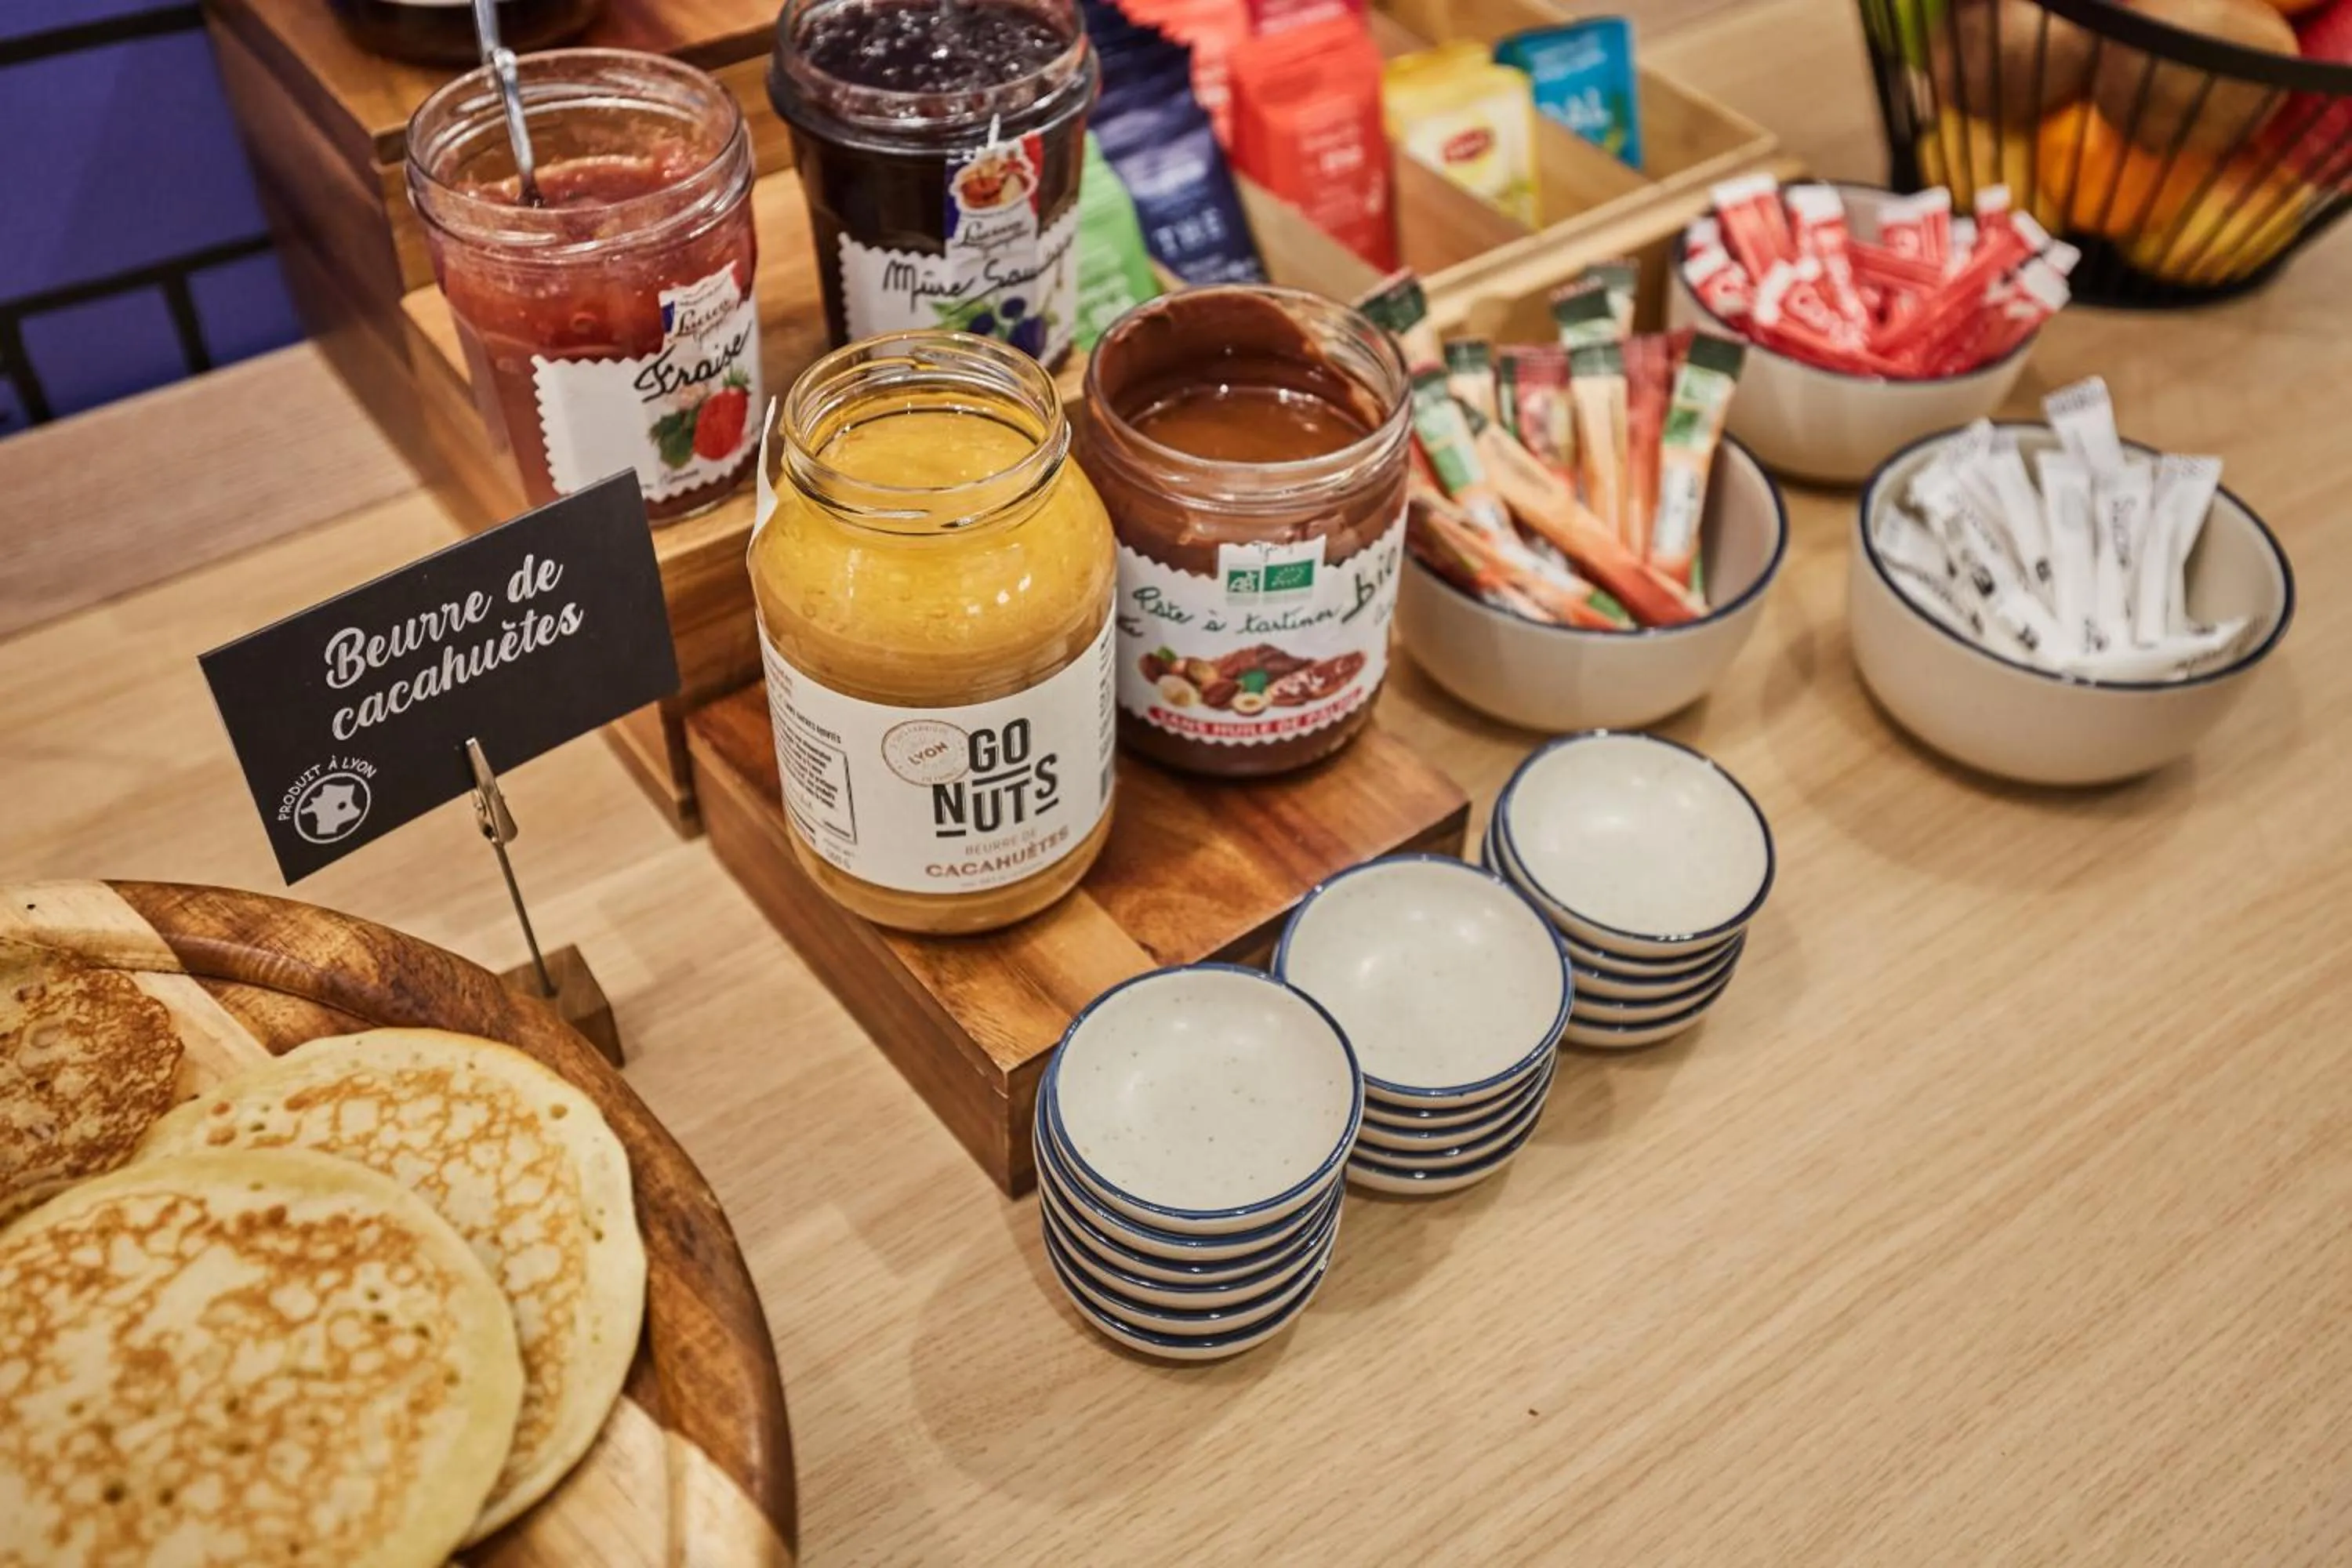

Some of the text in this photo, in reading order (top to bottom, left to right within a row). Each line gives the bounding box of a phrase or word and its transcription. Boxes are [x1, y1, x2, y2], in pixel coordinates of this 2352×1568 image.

[633, 319, 753, 404] Fraise
[324, 554, 564, 690] Beurre de
[908, 741, 949, 766] LYON
[968, 717, 1032, 773] GO
[278, 764, 321, 821] PRODUIT
[341, 757, 377, 779] LYON
[932, 752, 1058, 833] NUTS
